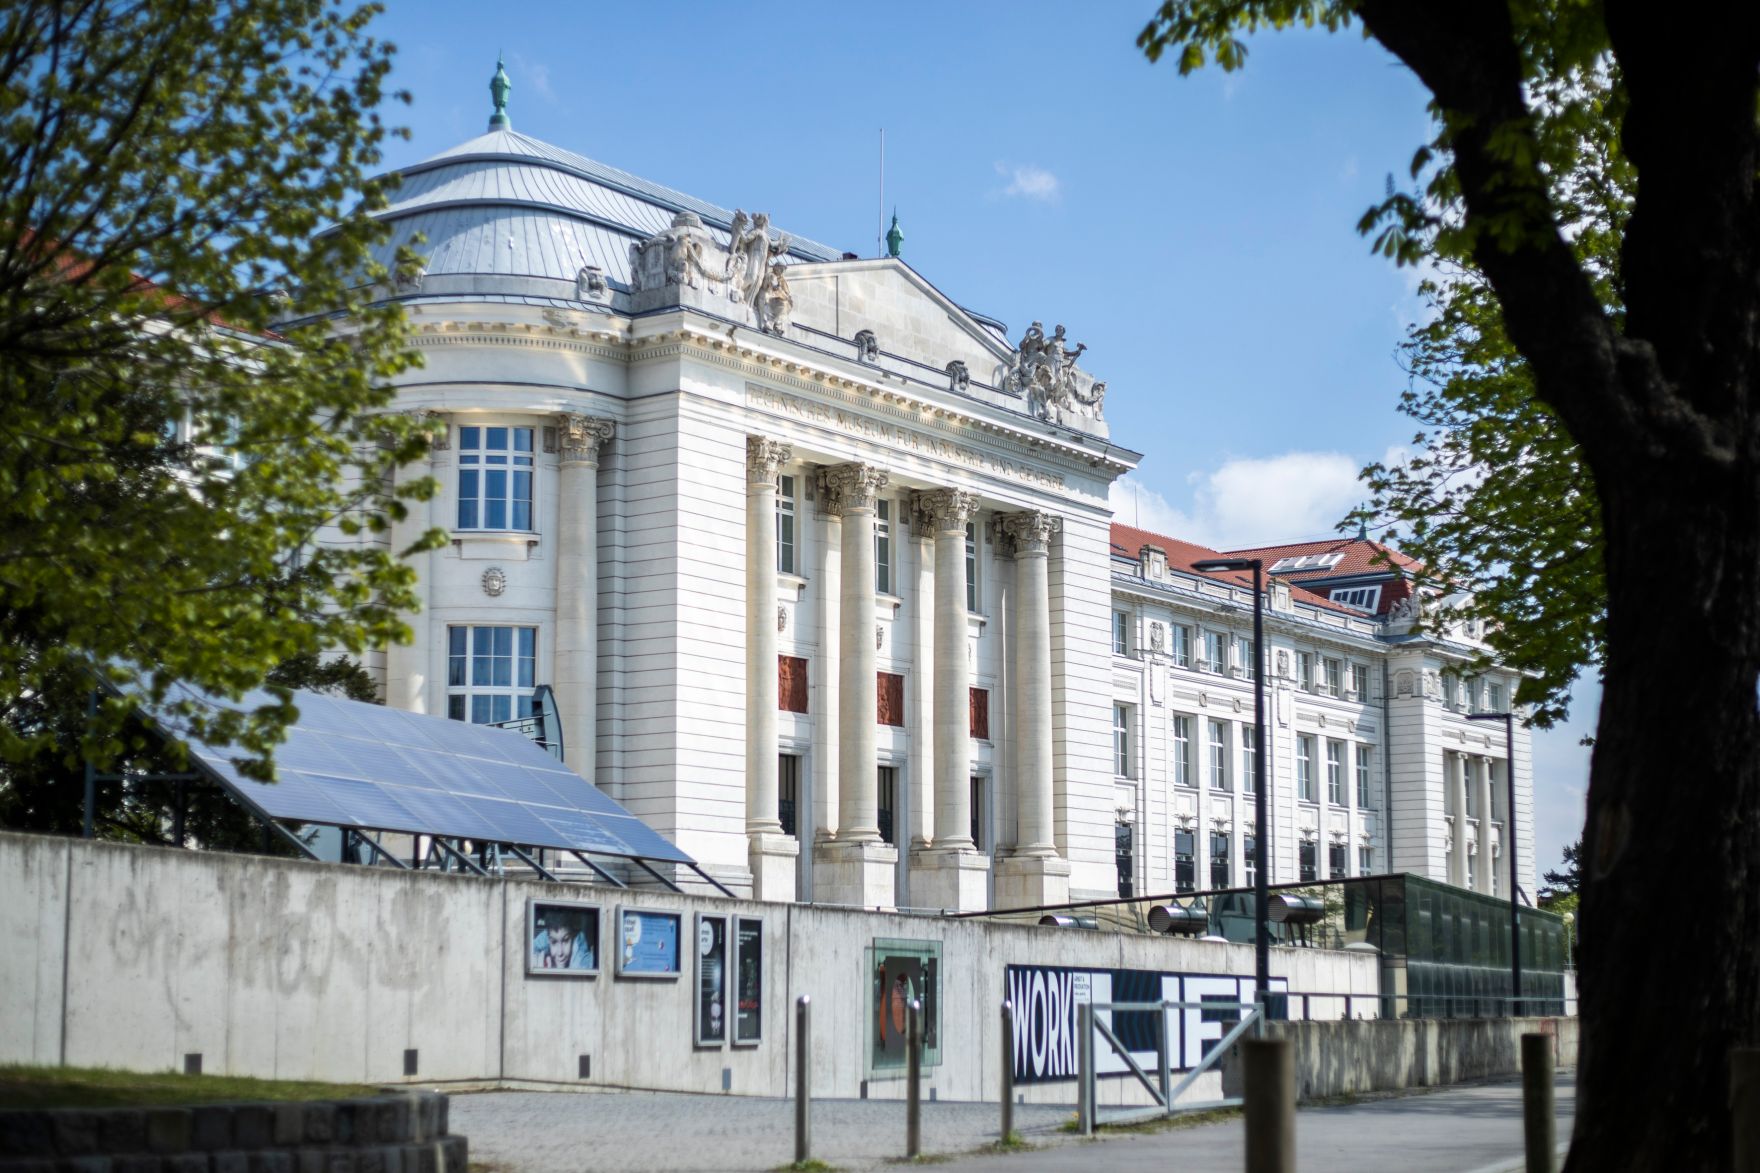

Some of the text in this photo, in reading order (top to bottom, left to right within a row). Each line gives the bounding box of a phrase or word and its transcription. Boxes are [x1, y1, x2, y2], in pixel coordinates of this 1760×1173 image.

[751, 388, 829, 419] TECHNISCHES
[837, 412, 889, 441] MUSEUM
[925, 438, 985, 468] INDUSTRIE
[990, 454, 1013, 476] UND
[1019, 466, 1063, 489] GEWERBE
[1009, 970, 1073, 1077] WORK
